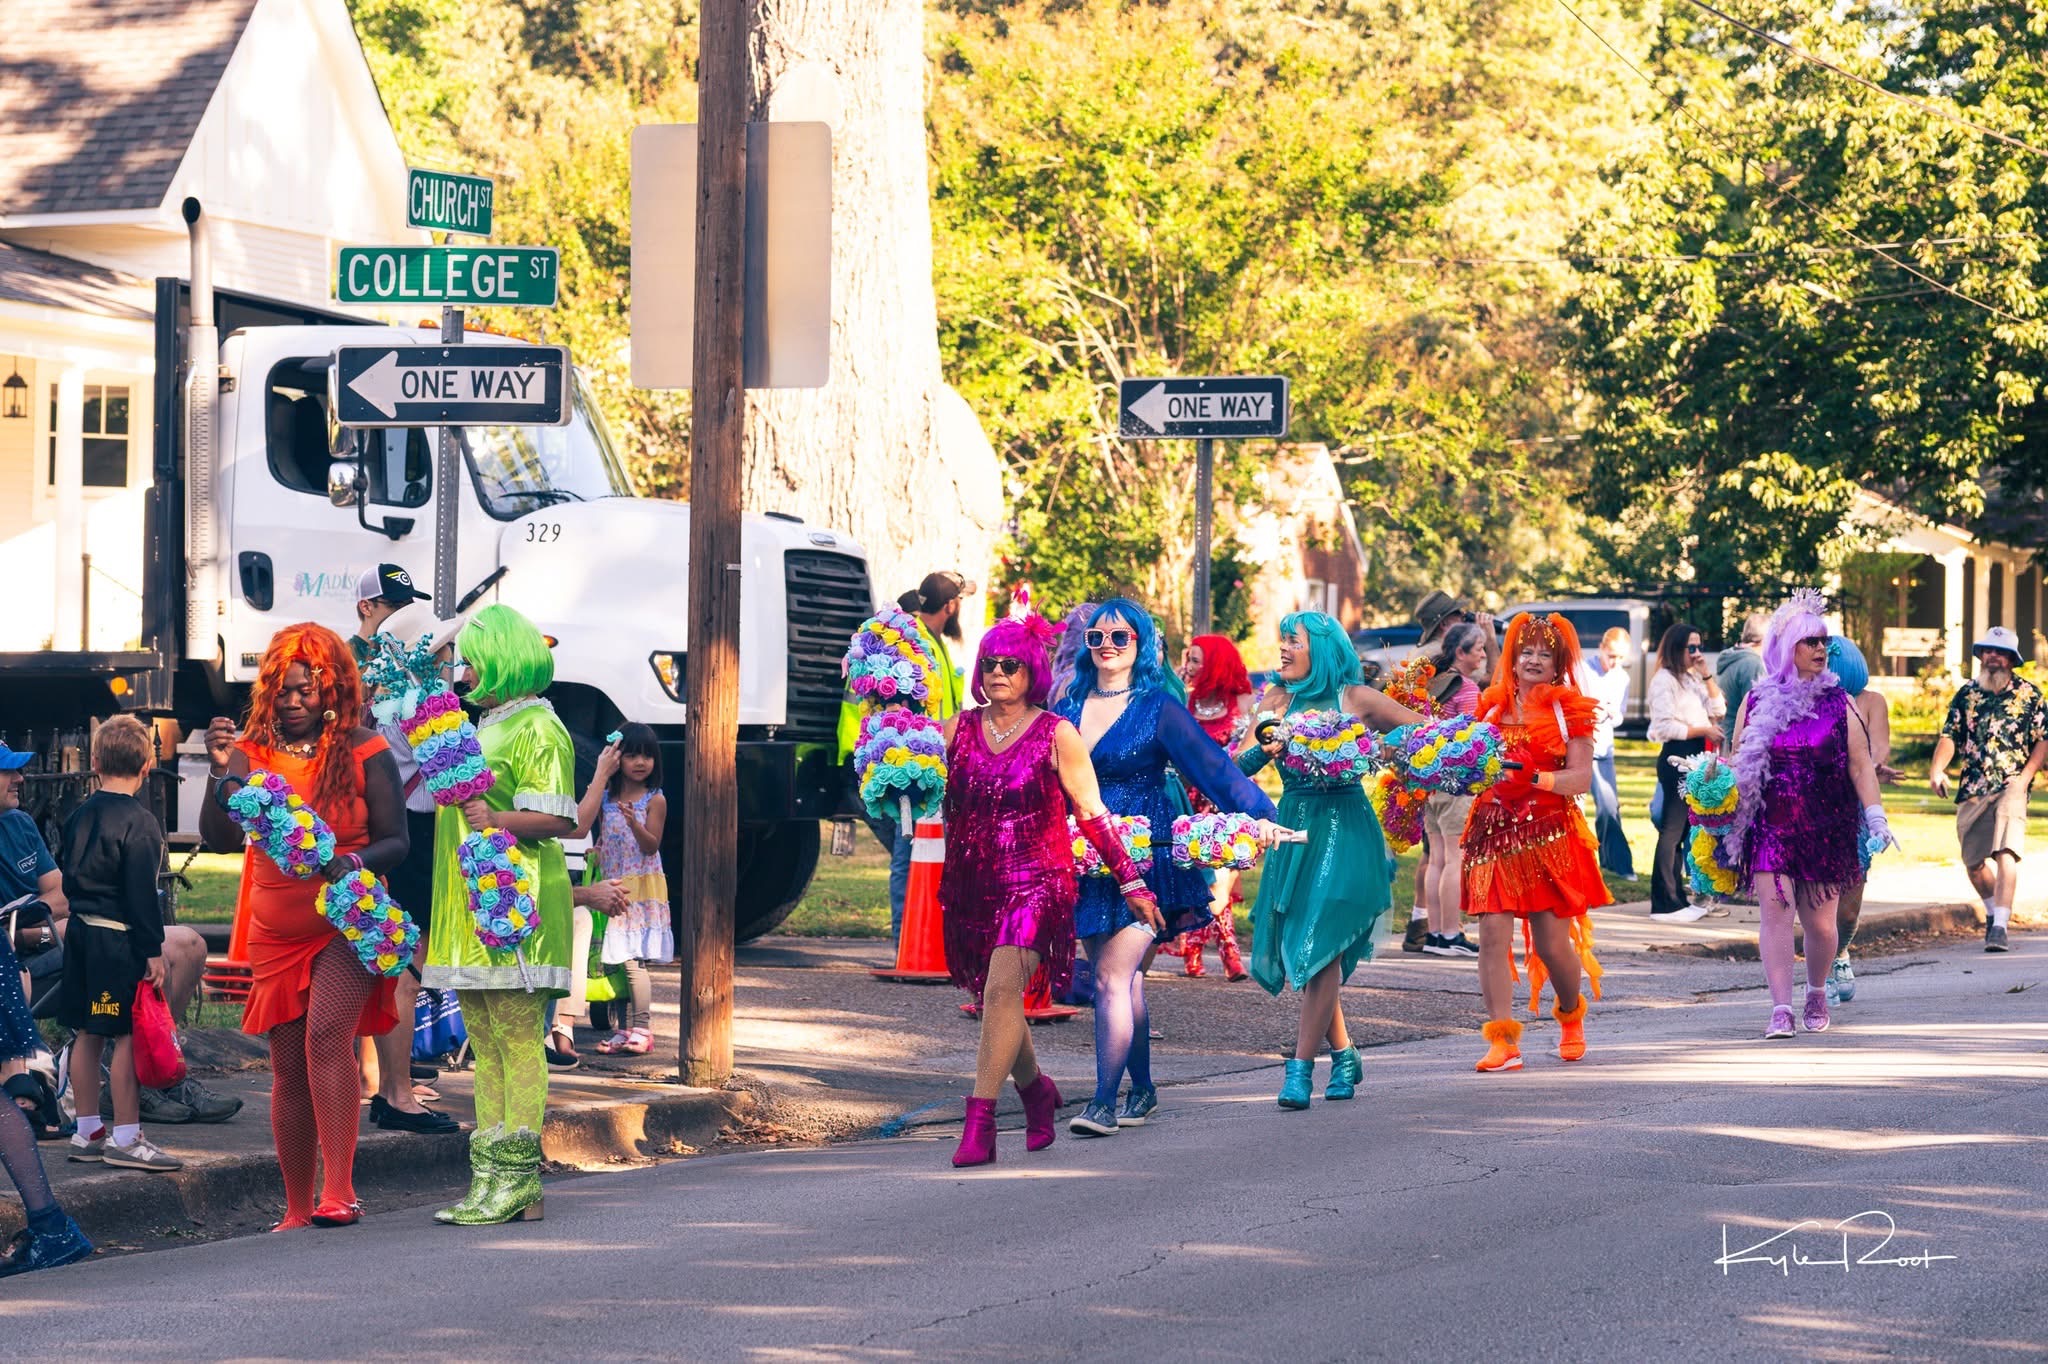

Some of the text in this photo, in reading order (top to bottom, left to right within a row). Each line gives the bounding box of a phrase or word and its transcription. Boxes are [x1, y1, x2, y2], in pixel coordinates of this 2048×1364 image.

[411, 176, 492, 227] CHURCH ST
[348, 253, 550, 298] COLLEGE ST
[401, 370, 535, 399] ONE WAY
[1168, 395, 1265, 418] ONE WAY
[526, 522, 561, 542] 329
[91, 1001, 120, 1016] MARINES
